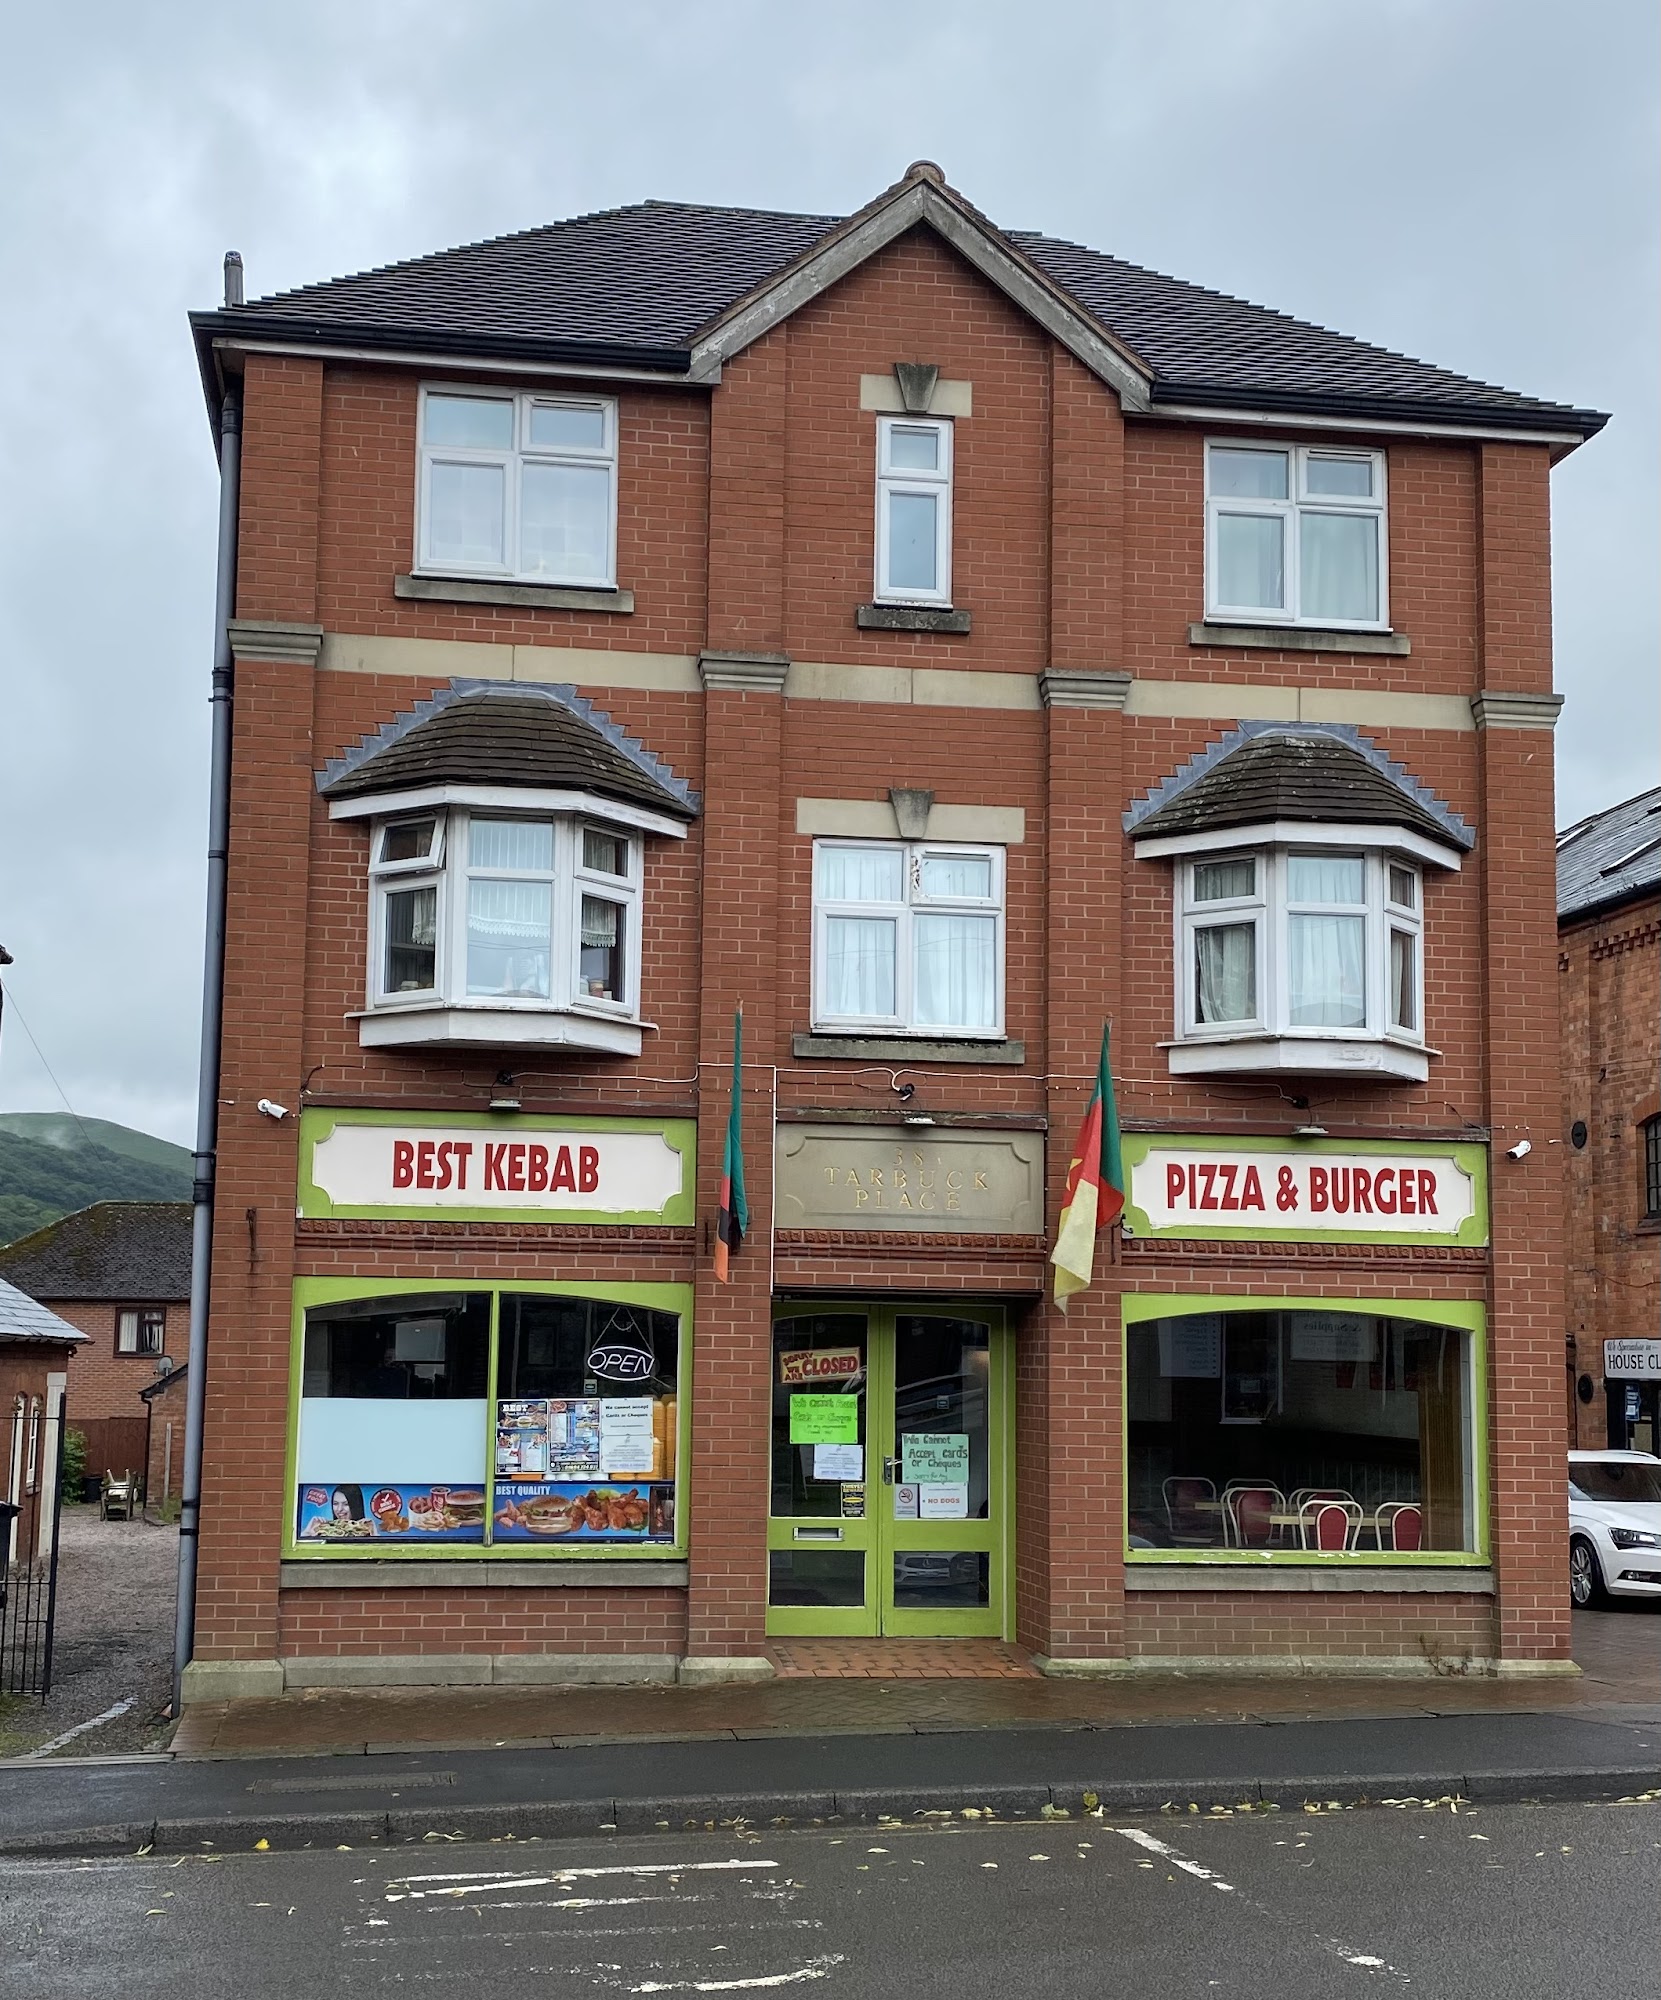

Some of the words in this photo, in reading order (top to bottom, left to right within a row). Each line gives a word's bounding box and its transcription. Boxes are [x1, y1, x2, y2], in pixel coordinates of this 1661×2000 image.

[393, 1140, 472, 1190] BEST
[484, 1143, 600, 1193] KEBAB
[824, 1167, 988, 1190] TARBUCK
[1166, 1163, 1266, 1211] PIZZA
[1276, 1165, 1299, 1211] &
[1309, 1166, 1439, 1215] BURGER
[855, 1189, 960, 1210] PLACE
[588, 1352, 655, 1374] OPEN
[783, 1352, 814, 1366] SORRY
[802, 1355, 858, 1376] CLOSED
[1608, 1354, 1644, 1369] HOUSE
[496, 1486, 516, 1496] BEST
[517, 1486, 551, 1496] QUALITY
